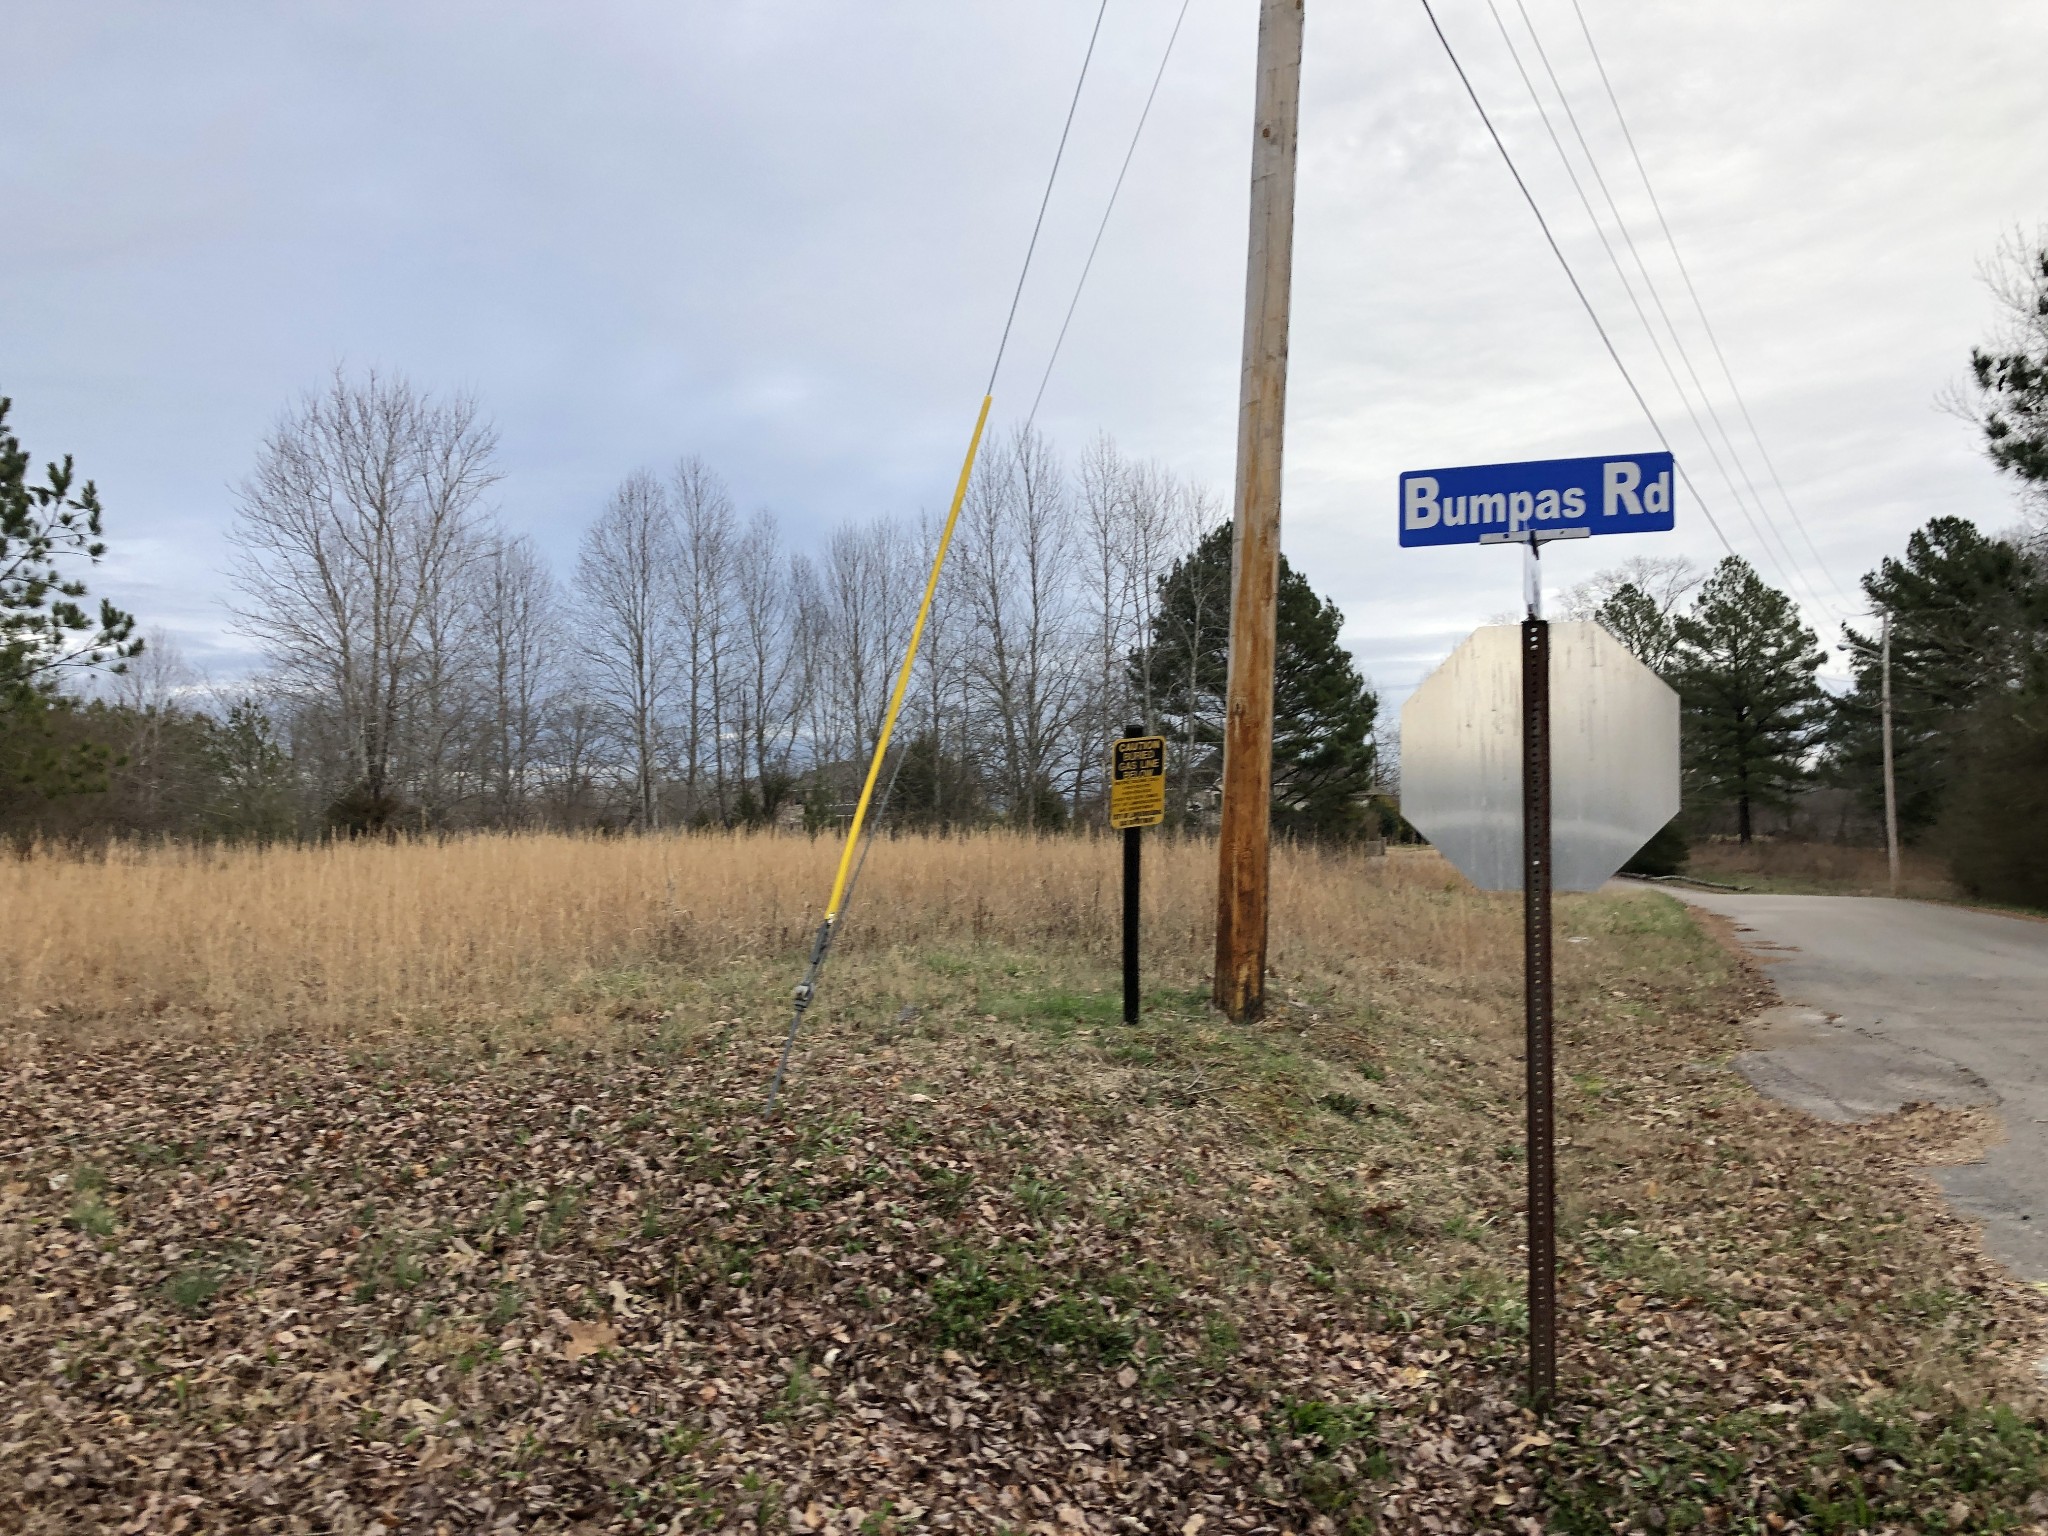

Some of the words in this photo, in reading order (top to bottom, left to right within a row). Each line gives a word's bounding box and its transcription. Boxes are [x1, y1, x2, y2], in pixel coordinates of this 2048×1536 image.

[1404, 476, 1587, 532] Bumpas
[1602, 461, 1671, 516] Rd
[1118, 741, 1160, 752] CAUTION
[1123, 750, 1155, 761] BURIED
[1118, 762, 1138, 771] GAS
[1141, 760, 1160, 769] LINE
[1123, 770, 1154, 779] BELOW
